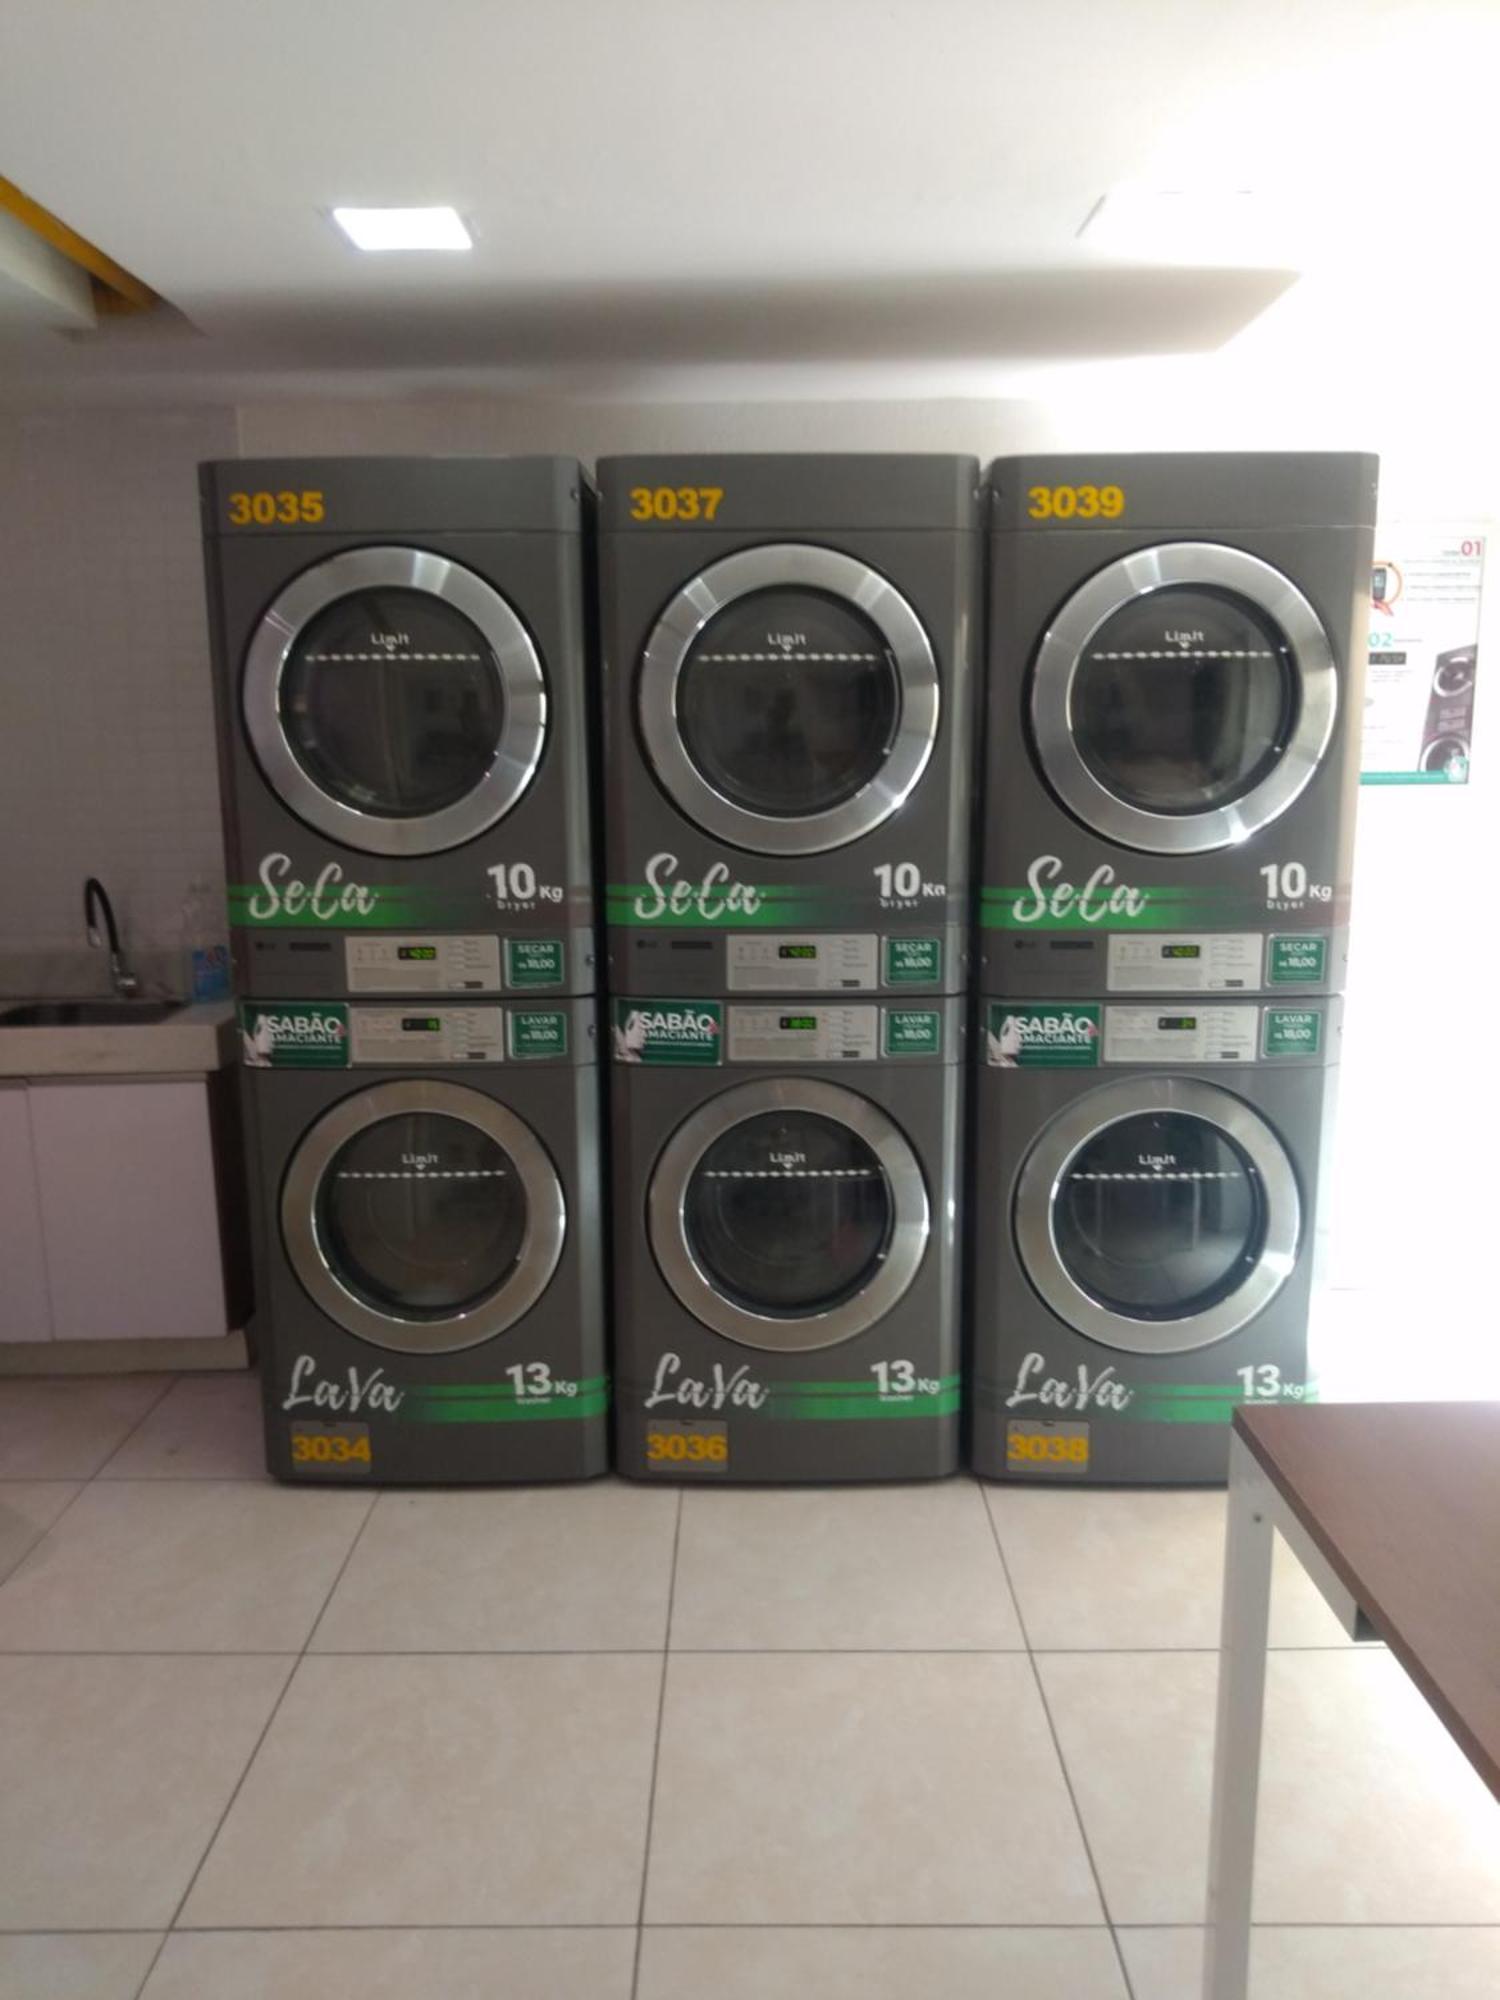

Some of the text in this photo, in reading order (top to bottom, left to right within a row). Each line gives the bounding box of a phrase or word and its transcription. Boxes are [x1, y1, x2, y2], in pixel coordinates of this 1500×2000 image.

[228, 491, 324, 524] 3035
[629, 486, 724, 520] 3037
[1027, 484, 1125, 518] 3039
[1461, 540, 1482, 556] 01
[371, 633, 410, 646] Limit
[767, 633, 806, 646] Limit
[1165, 630, 1205, 643] Limit
[1367, 632, 1392, 647] 02
[249, 852, 380, 920] SeCa
[487, 862, 564, 903] 10 Kg
[634, 852, 766, 920] SeCa
[873, 862, 920, 898] 10
[1012, 854, 1150, 922] SeCa
[1259, 862, 1333, 902] 10 Kg
[517, 944, 555, 954] SECAR
[894, 943, 932, 952] SECAR
[1279, 942, 1317, 952] SECAR
[267, 1012, 342, 1034] SABÃO
[521, 1016, 558, 1025] LAVAR
[639, 1009, 714, 1030] SABÃO
[895, 1015, 931, 1024] LAVAR
[1015, 1012, 1092, 1034] SABÃO
[1275, 1014, 1313, 1024] LAVAR
[402, 1152, 440, 1164] Limit
[769, 1151, 806, 1163] Limit
[1138, 1154, 1177, 1166] Limit
[282, 1354, 404, 1413] LaVa
[505, 1361, 578, 1398] 13 Kg
[644, 1352, 770, 1411] LaVa
[870, 1359, 940, 1394] 13 Kg
[1004, 1352, 1134, 1411] LaVa
[1236, 1363, 1305, 1399] 13 Kg
[292, 1434, 371, 1462] 3034
[646, 1433, 727, 1462] 3036
[1007, 1433, 1089, 1462] 3038
